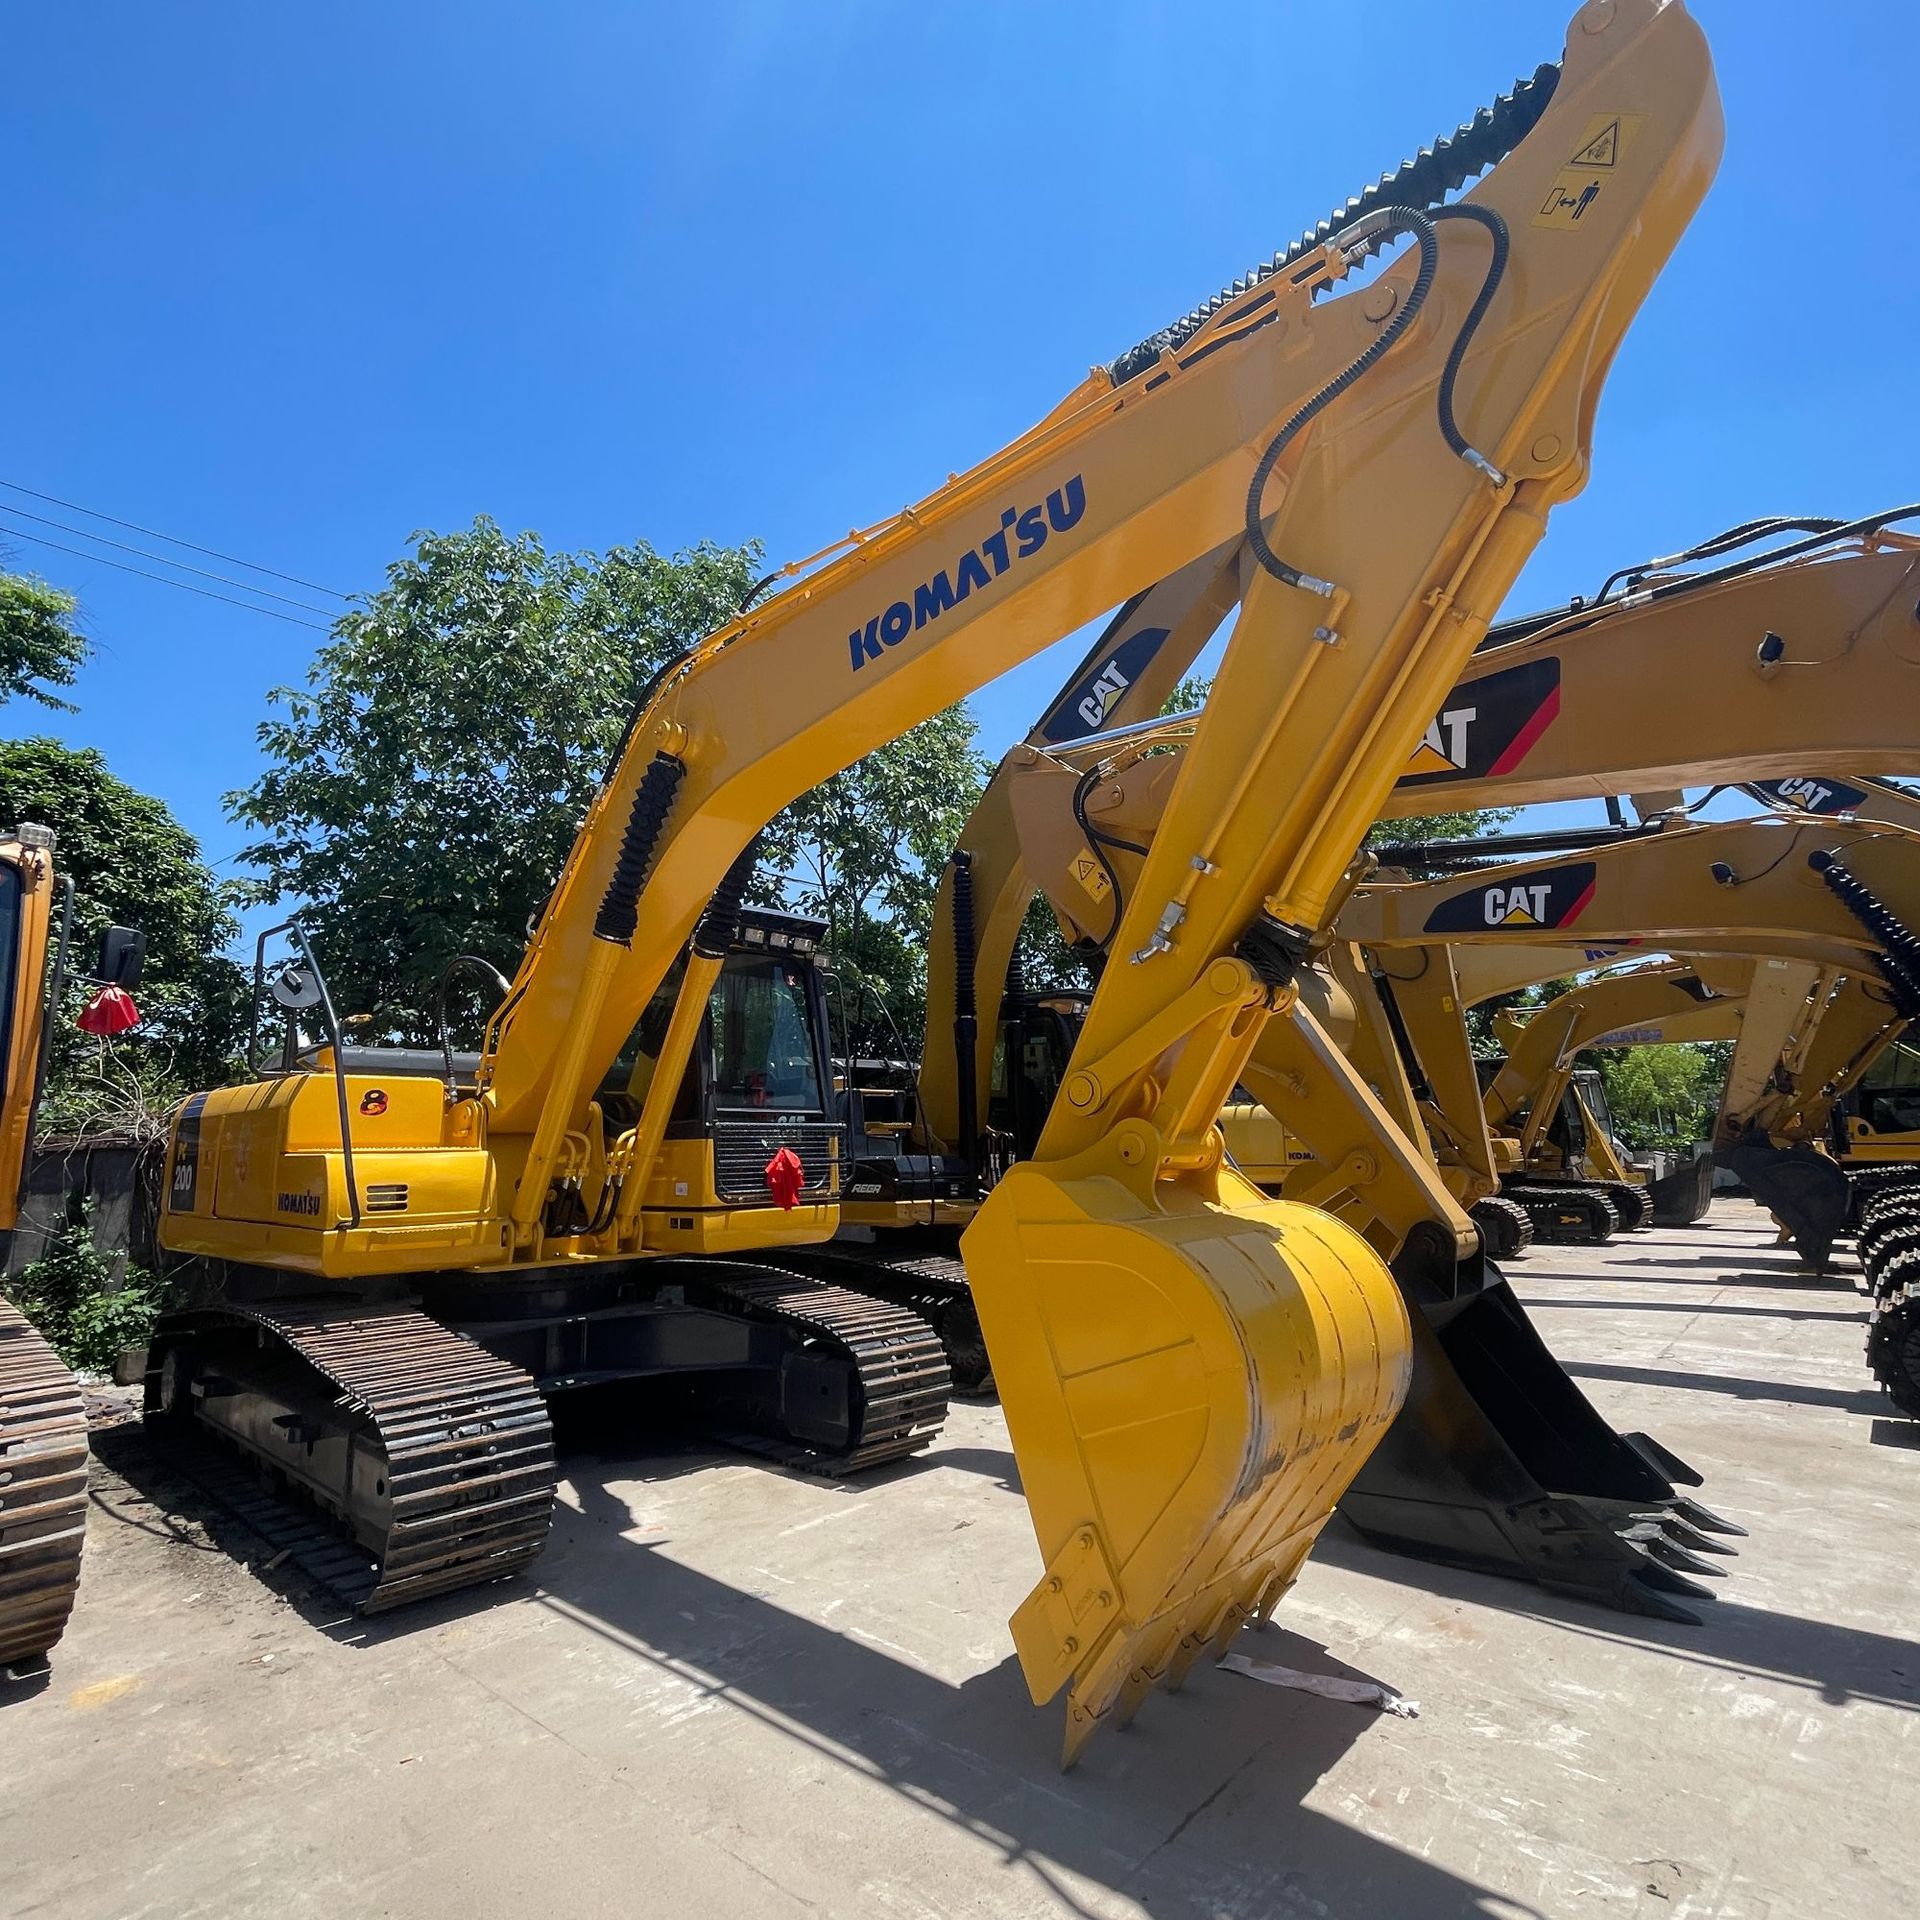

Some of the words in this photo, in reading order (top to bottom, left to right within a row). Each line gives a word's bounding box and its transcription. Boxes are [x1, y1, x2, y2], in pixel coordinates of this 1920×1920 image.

[848, 473, 1086, 672] KOMATSU
[1078, 659, 1130, 727] CAT
[1408, 707, 1477, 769] AT
[1777, 777, 1833, 810] CAT
[1484, 885, 1552, 925] CAT
[1287, 1151, 1316, 1161] KOM
[174, 1164, 193, 1191] 200
[277, 1189, 321, 1216] KOMATSU
